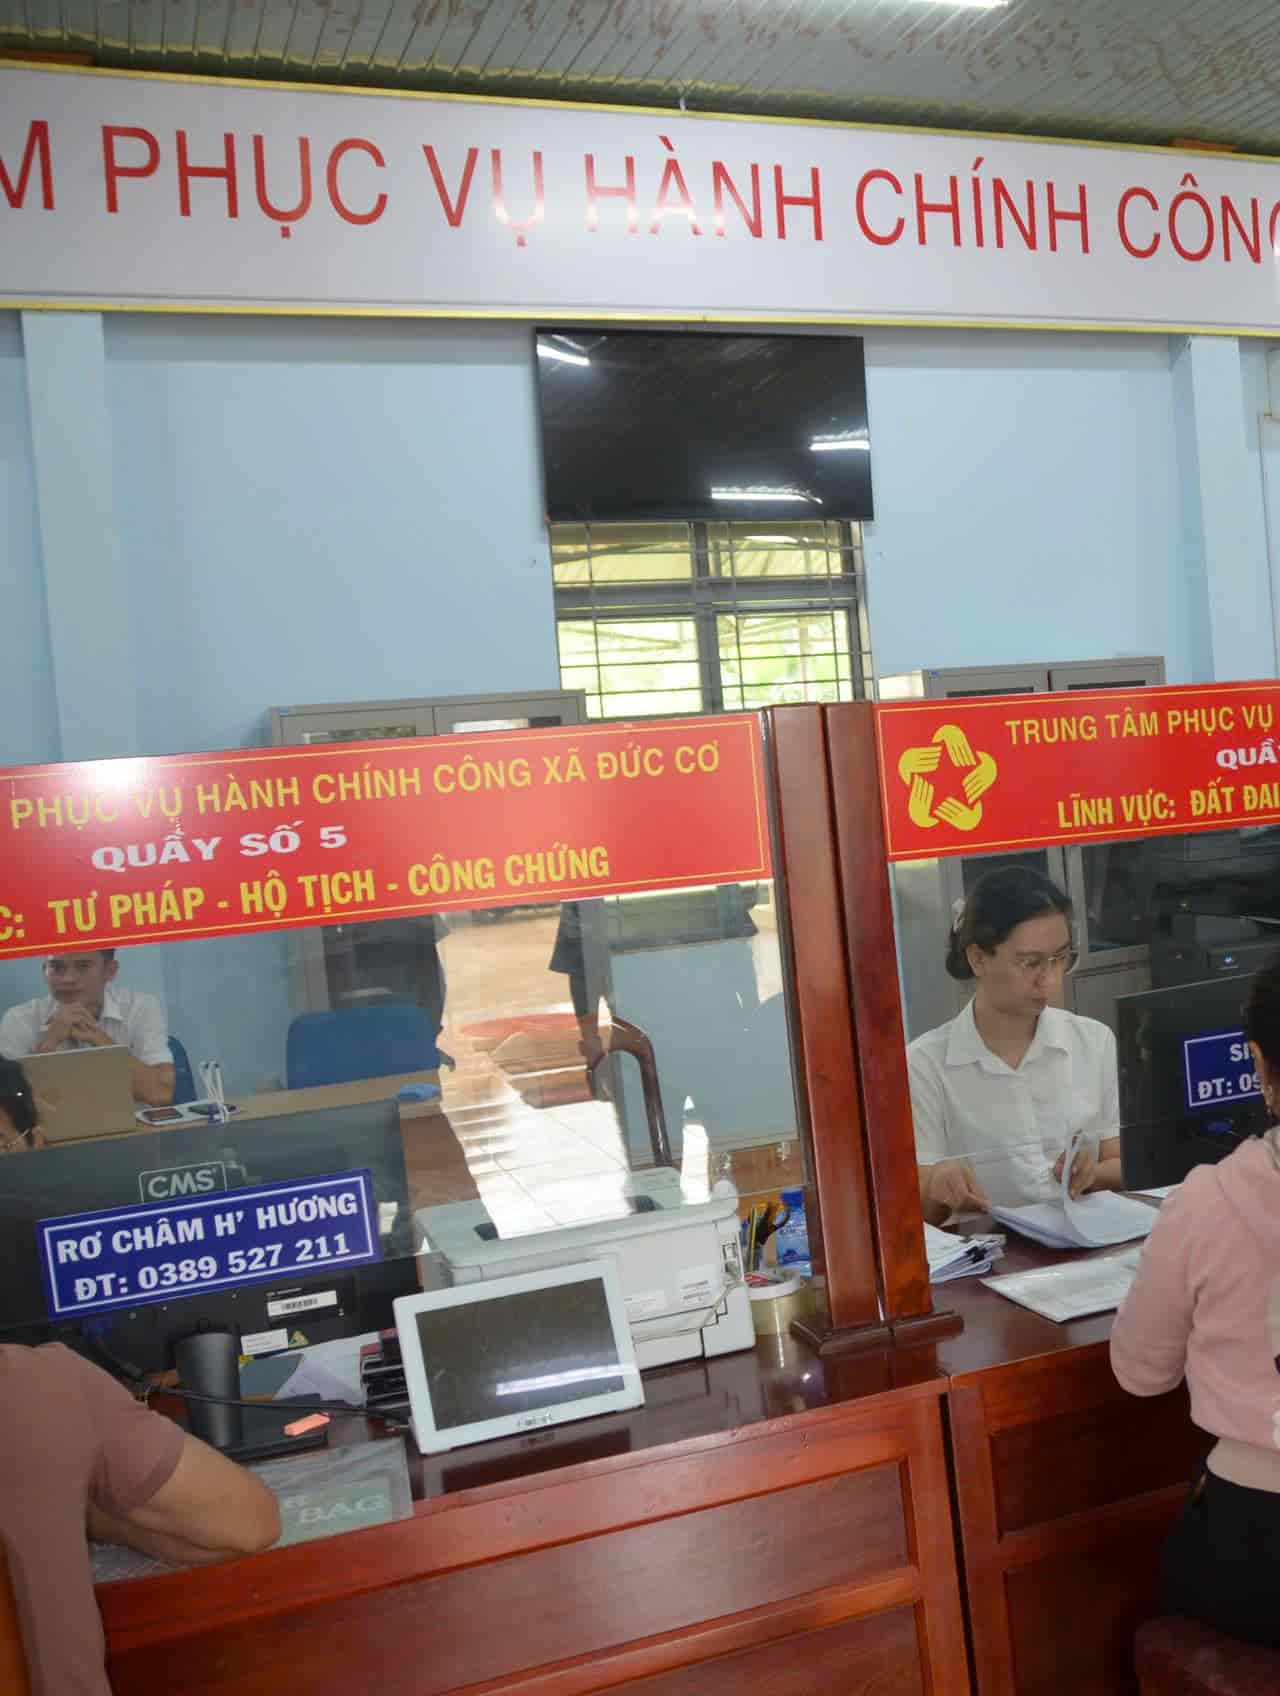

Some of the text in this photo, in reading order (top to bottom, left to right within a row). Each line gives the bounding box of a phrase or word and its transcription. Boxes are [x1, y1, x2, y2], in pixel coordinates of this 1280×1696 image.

[102, 124, 388, 239] PHỤC
[422, 144, 545, 247] VỤ
[584, 135, 823, 241] HÀNH
[856, 157, 1090, 254] CHÍNH
[1005, 715, 1097, 745] TRUNG
[1105, 707, 1159, 738] TÂM
[1167, 706, 1235, 736] PHỤC
[1241, 703, 1273, 733] VỤ
[10, 740, 720, 831] PHỤC VỤ HÀNH CHÍNH CÔNG XÃ ĐỨC CƠ
[1057, 793, 1113, 829] LĨNH
[1120, 788, 1177, 826] VỰC:
[1190, 777, 1235, 817] ĐẤT
[1243, 783, 1280, 812] ĐAI
[239, 820, 304, 857] SỐ
[320, 825, 347, 849] 5
[48, 889, 97, 935] TƯ
[110, 880, 204, 929] PHÁP
[240, 869, 288, 919] HỘ
[298, 869, 375, 914] TỊCH
[408, 854, 496, 896] CÔNG
[504, 841, 610, 887] CHỨNG
[1198, 1077, 1233, 1100] ĐT:
[147, 1168, 216, 1199] CMS
[57, 1231, 103, 1264] RƠ
[112, 1217, 204, 1254] CHÂM
[256, 1192, 359, 1230] HƯƠNG
[74, 1231, 351, 1302] ĐT: 0389 527 211
